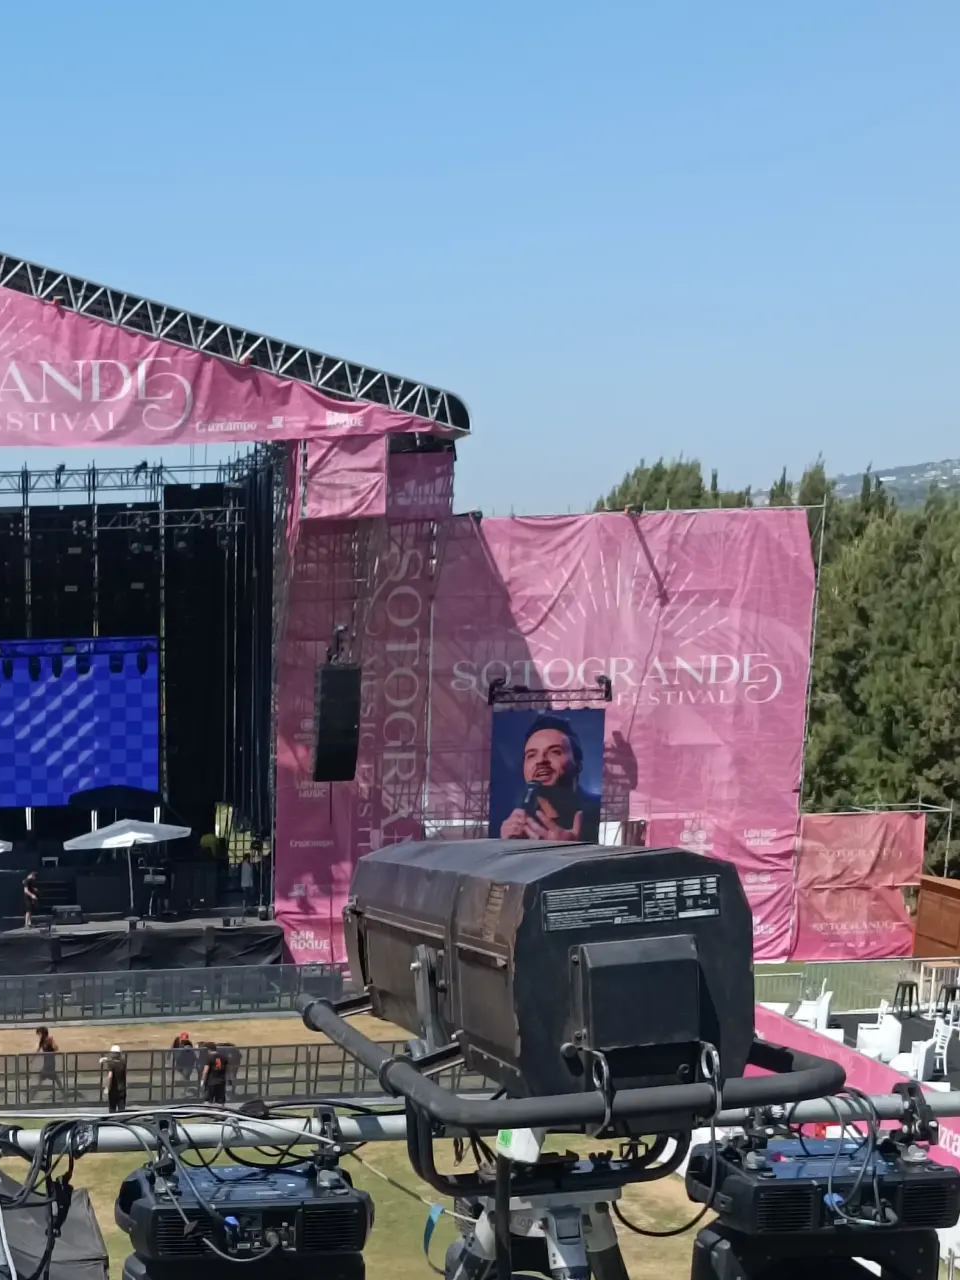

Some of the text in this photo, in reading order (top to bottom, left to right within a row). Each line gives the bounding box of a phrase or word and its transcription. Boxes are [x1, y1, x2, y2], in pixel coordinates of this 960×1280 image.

[195, 419, 257, 433] Cuzcampo
[450, 652, 782, 704] SOTOGRANDE
[363, 547, 424, 850] SOTOGRA
[617, 689, 736, 707] FESTIVAL
[290, 931, 315, 941] SAN
[290, 940, 330, 950] ROQUE
